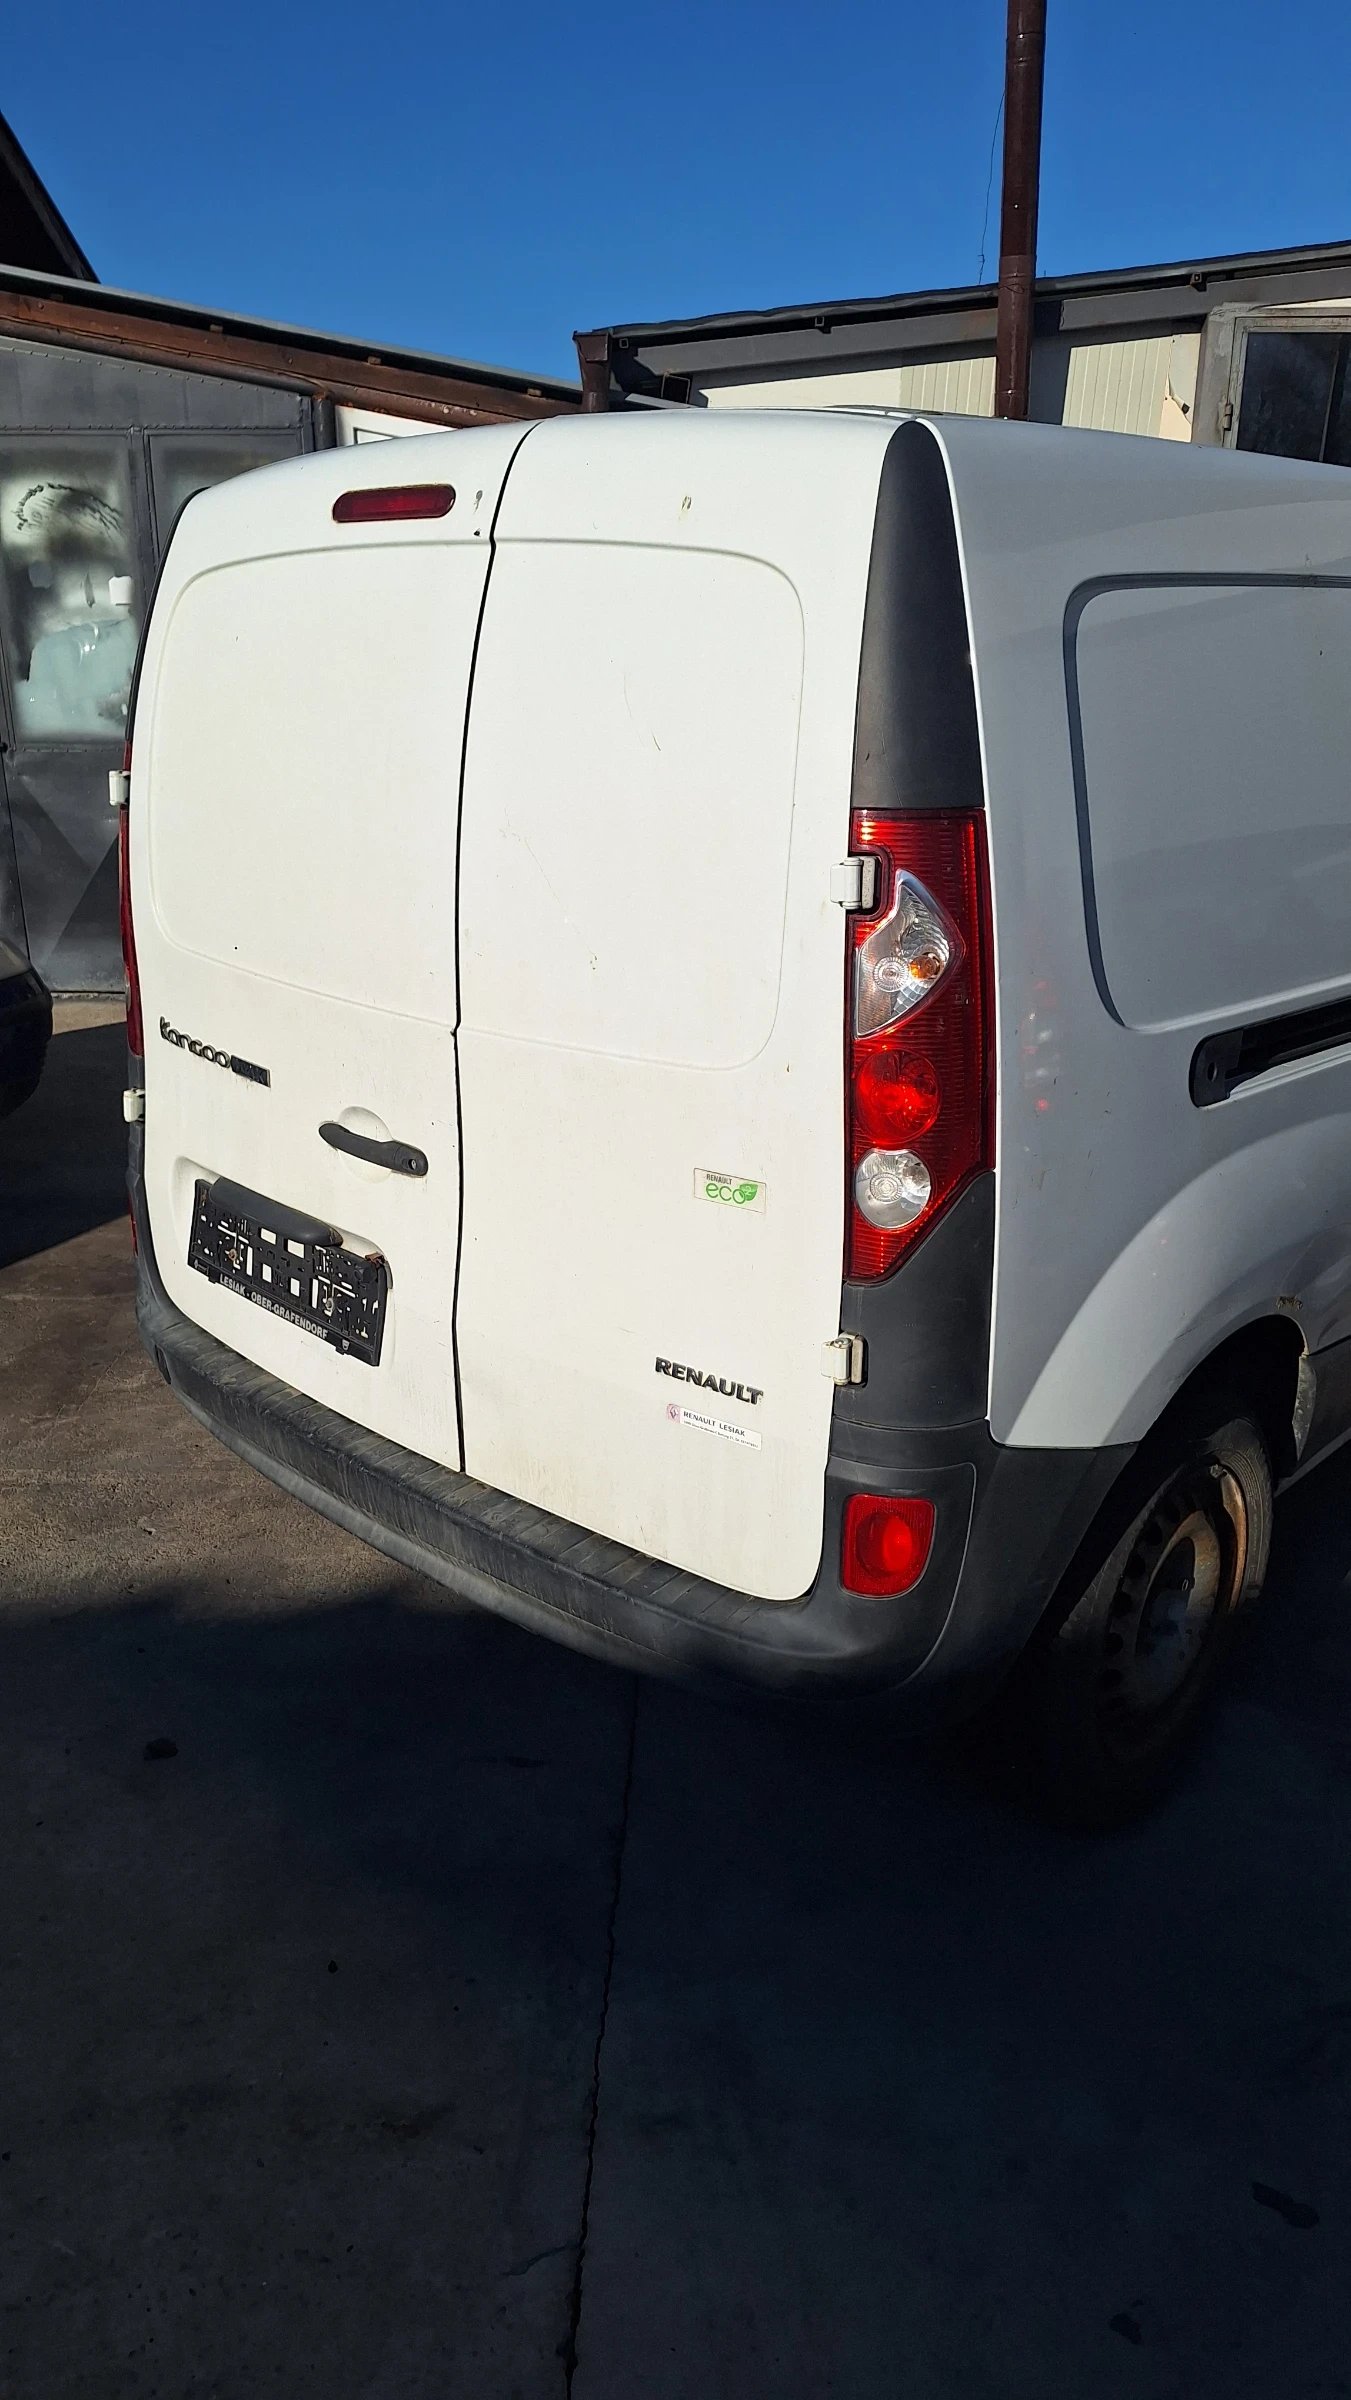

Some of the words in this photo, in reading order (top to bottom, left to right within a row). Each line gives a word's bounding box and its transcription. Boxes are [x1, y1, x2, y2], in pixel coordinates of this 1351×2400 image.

[706, 1173, 732, 1185] RENAULT
[219, 1273, 246, 1297] LESIAK
[251, 1291, 329, 1340] OBER-GRAFENDORF
[655, 1356, 764, 1405] RENAULT
[683, 1410, 716, 1427] RENAULT
[719, 1422, 746, 1437] LESIAK
